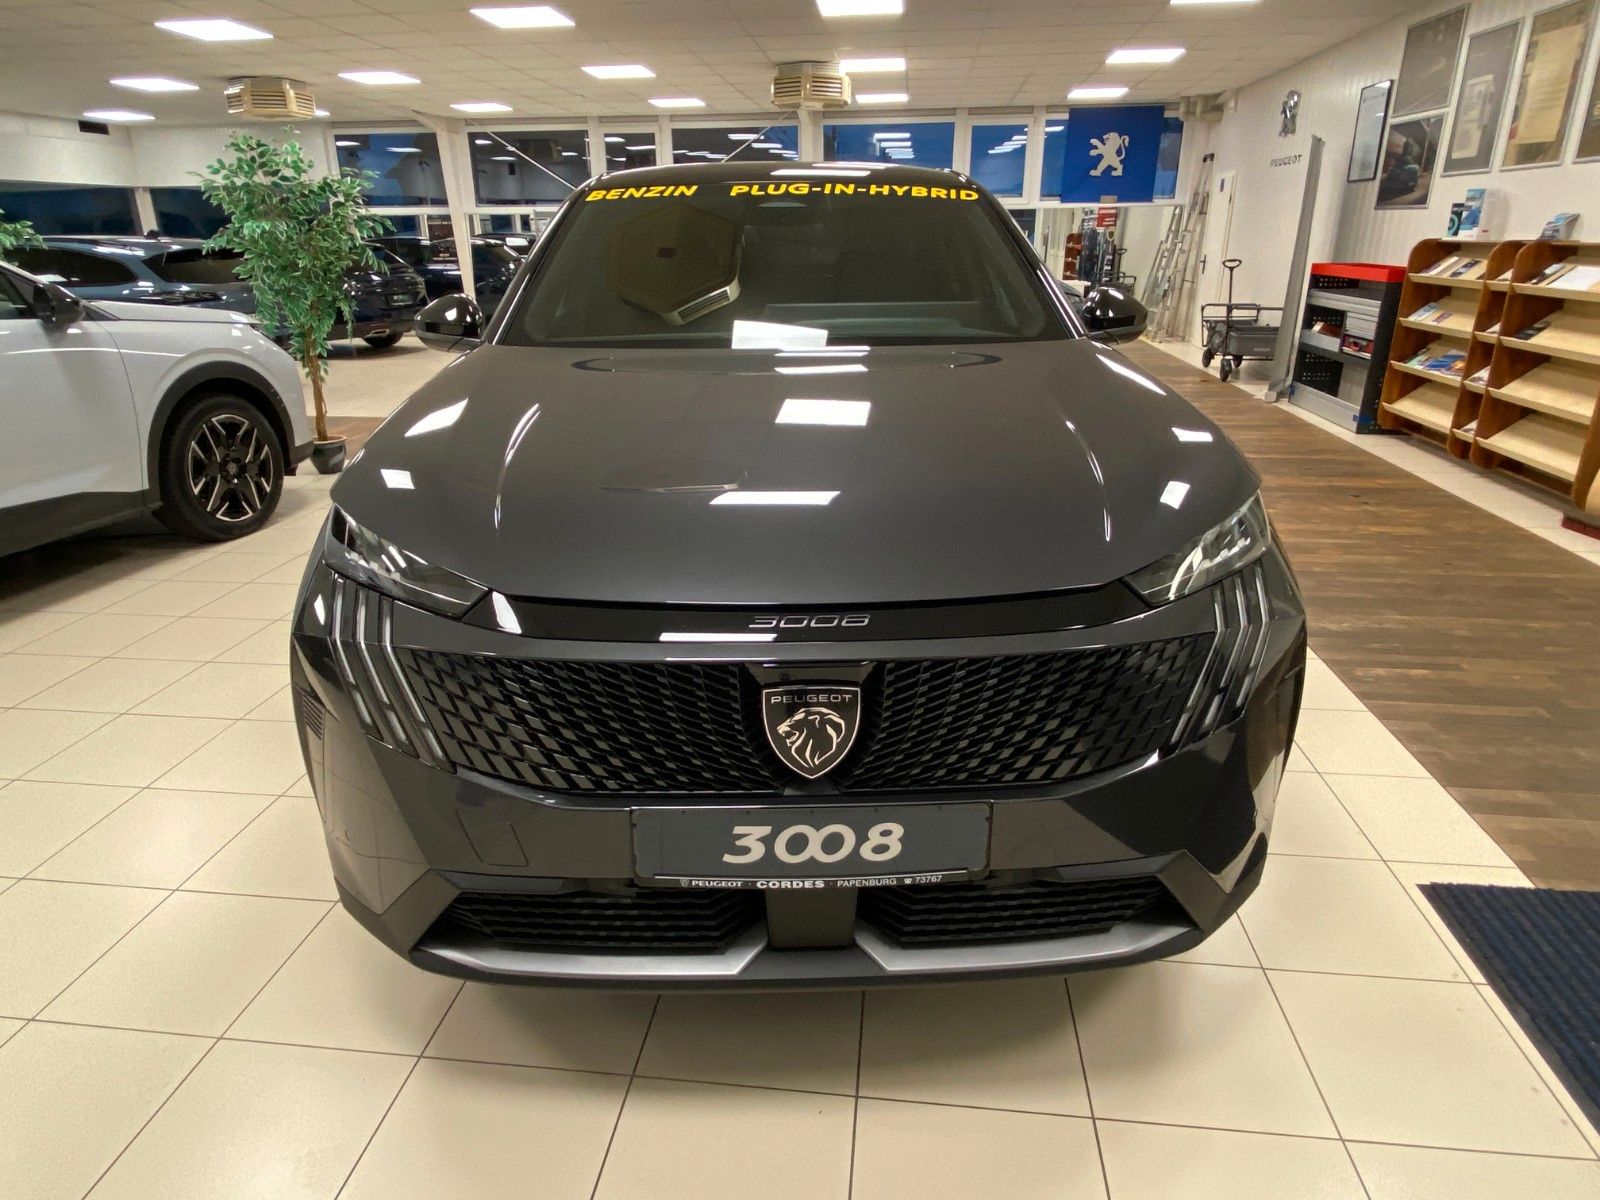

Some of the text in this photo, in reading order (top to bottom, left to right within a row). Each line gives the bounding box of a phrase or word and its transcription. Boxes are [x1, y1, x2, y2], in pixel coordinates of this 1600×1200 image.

[1269, 154, 1302, 168] PEUGEOT
[585, 183, 979, 203] BENZIN PLUG-IN-HYBRID
[748, 614, 871, 628] 3008
[771, 694, 853, 704] PEUGEOT
[722, 822, 905, 864] 3008
[691, 874, 943, 890] PEUGEOT CORDES PAPENBURG 73767
